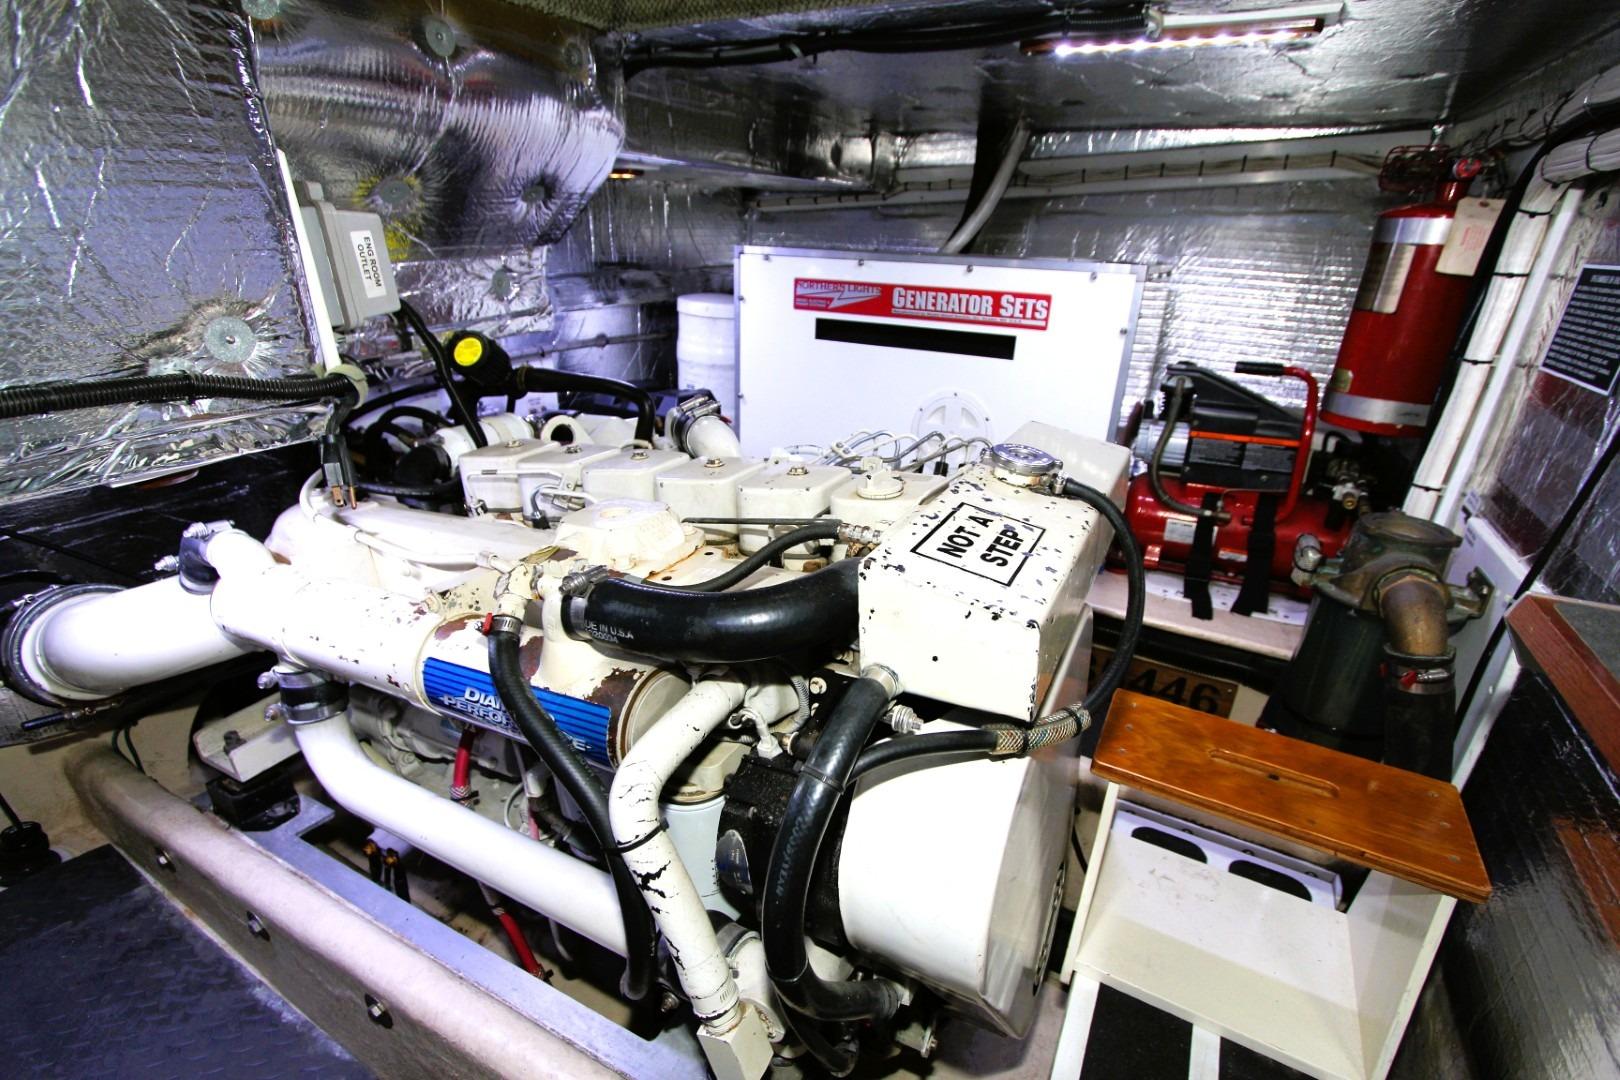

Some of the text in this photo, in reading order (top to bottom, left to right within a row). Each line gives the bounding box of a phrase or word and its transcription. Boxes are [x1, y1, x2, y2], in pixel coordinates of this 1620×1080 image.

[357, 243, 373, 281] OUTLET
[363, 236, 382, 287] ENG ROOM
[847, 284, 882, 294] LIGHTS
[892, 286, 994, 315] GENERATOR
[1000, 294, 1049, 320] SETS
[936, 514, 994, 559] NOT A
[980, 528, 1024, 567] STEP
